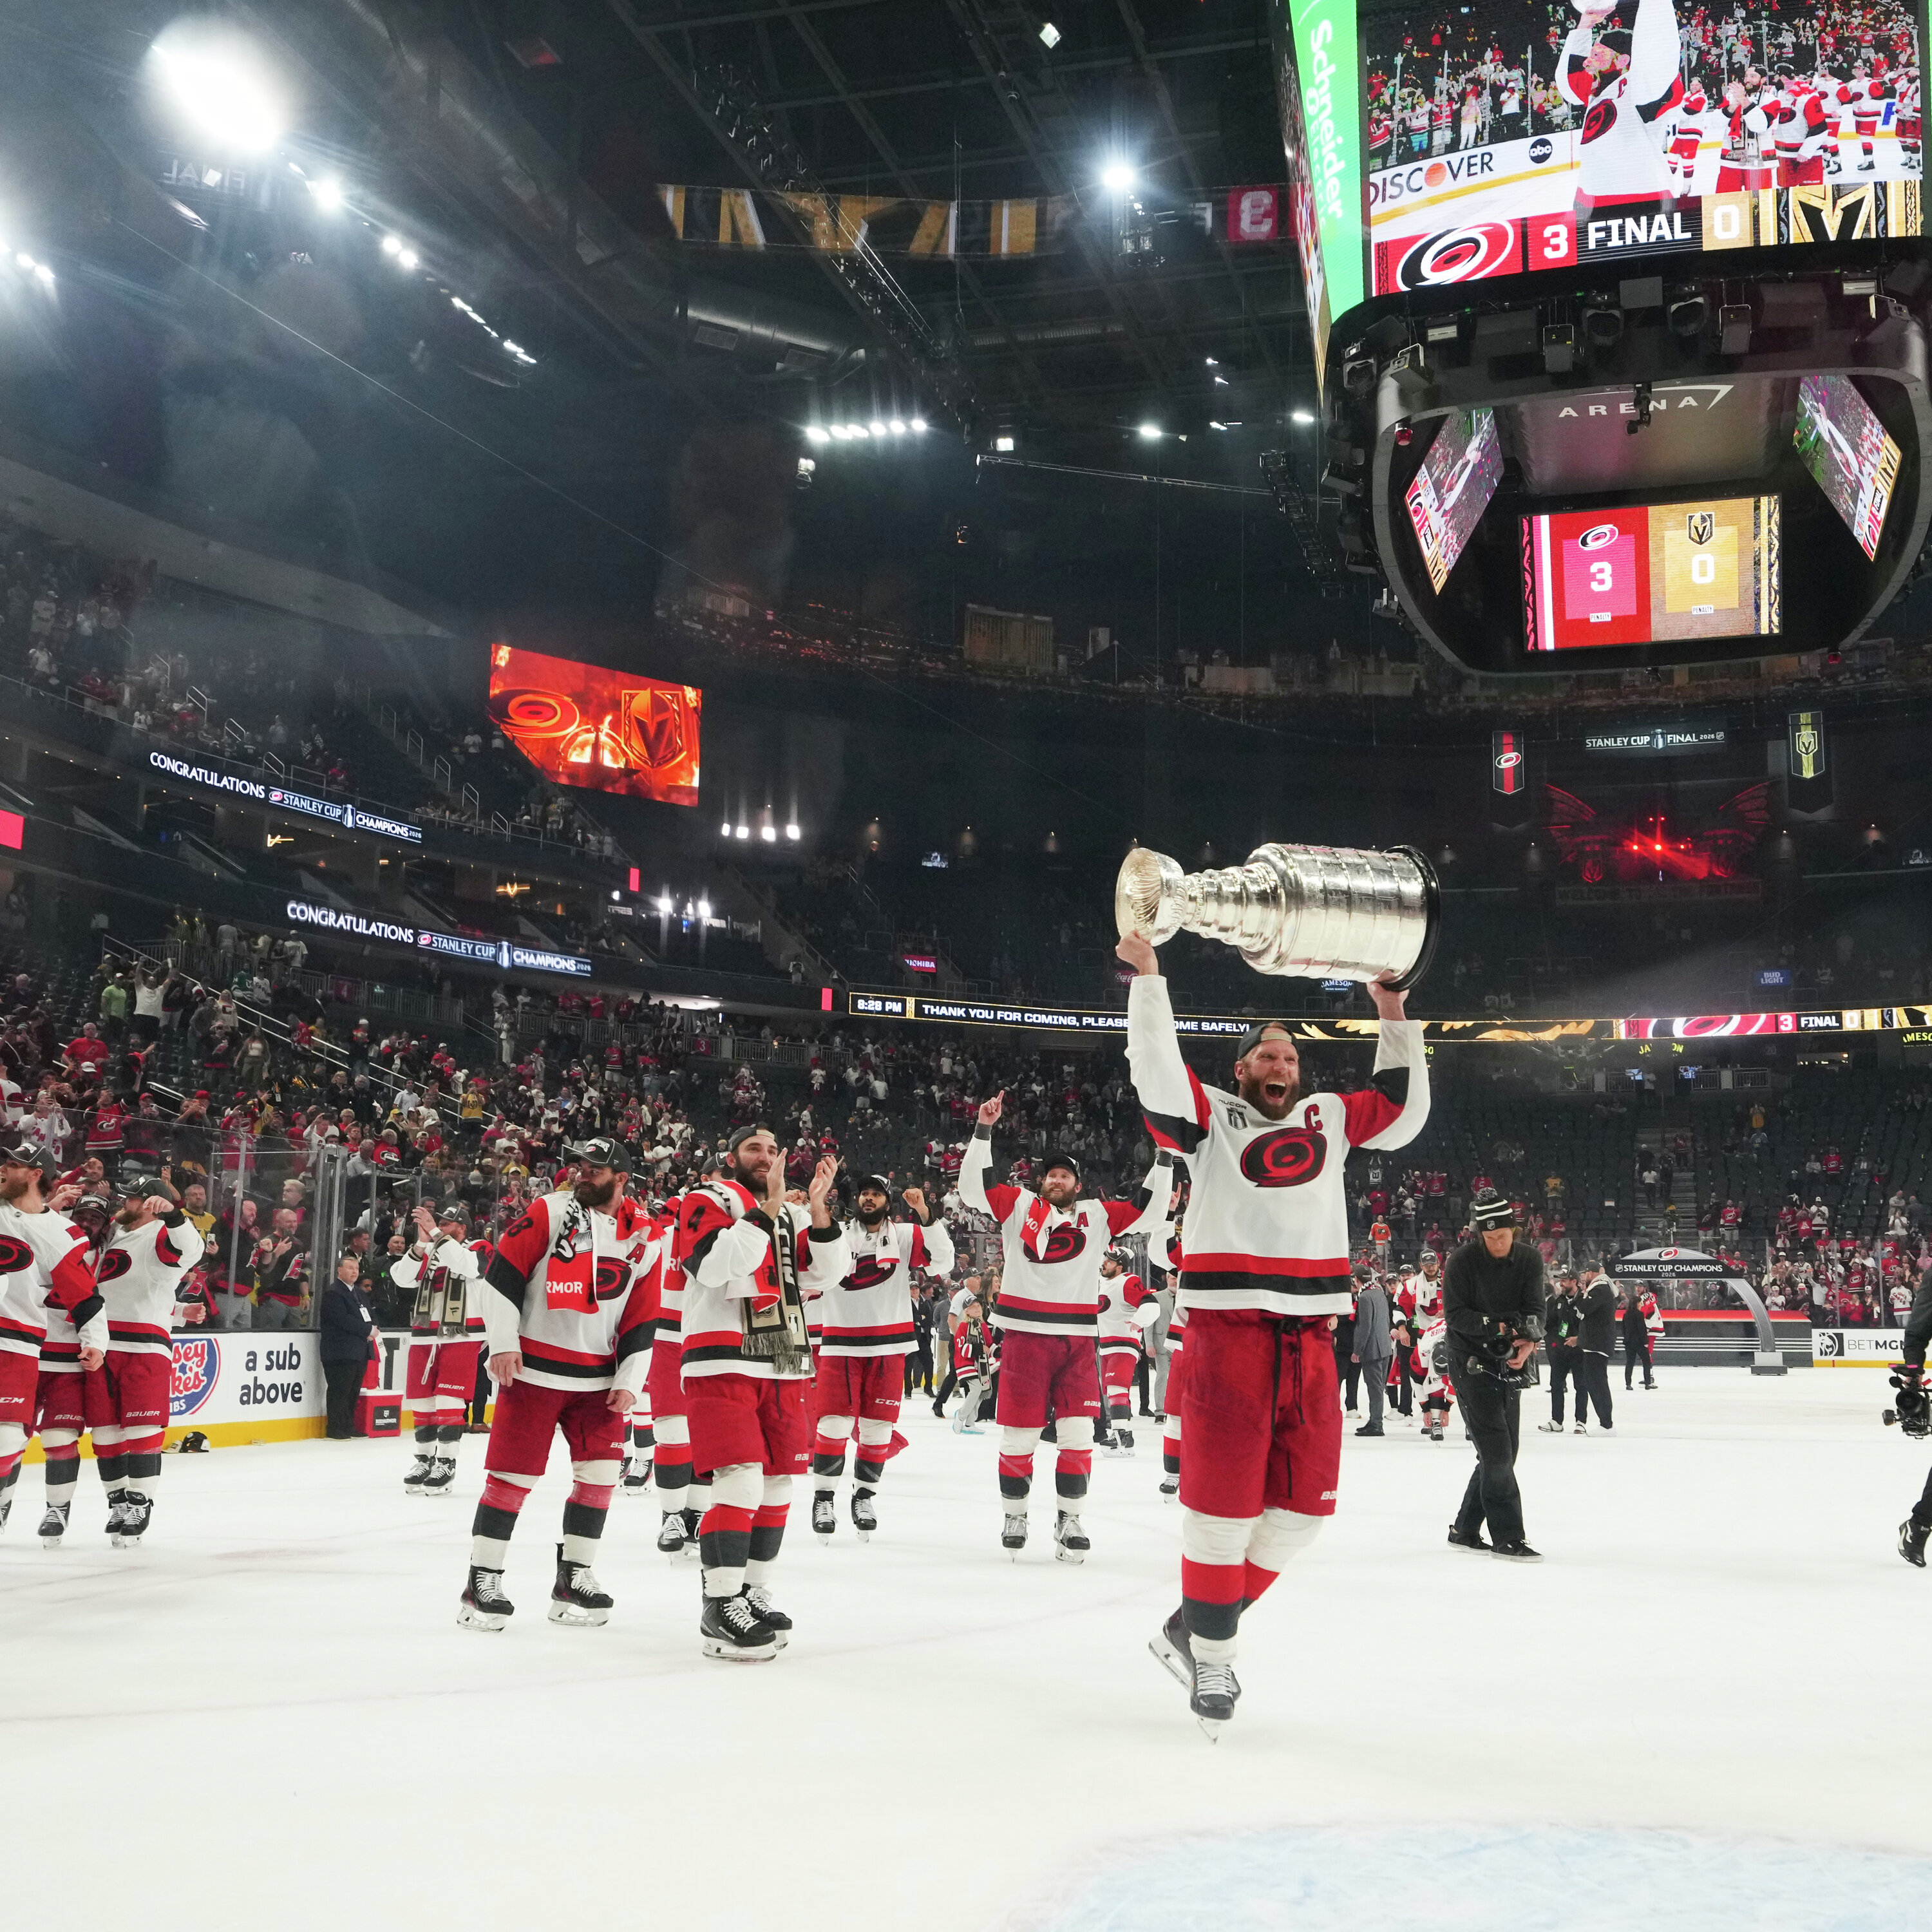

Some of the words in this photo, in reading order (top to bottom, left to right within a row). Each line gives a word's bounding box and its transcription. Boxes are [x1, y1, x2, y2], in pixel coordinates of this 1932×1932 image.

[1311, 19, 1345, 218] Schneider
[1530, 144, 1553, 158] abc
[1310, 120, 1325, 231] Electric
[1543, 224, 1568, 259] 3
[1587, 212, 1692, 249] FINAL
[1713, 204, 1739, 240] 0
[1558, 396, 1699, 418] ARENA
[1590, 562, 1613, 592] 3
[1691, 554, 1715, 584] 0
[1586, 737, 1629, 748] STANLEY
[1631, 735, 1651, 746] CUP
[1667, 734, 1698, 744] FINAL
[150, 752, 265, 799] CONGRATULATIONS
[283, 793, 323, 813] STANLEY
[324, 806, 341, 819] CUP
[355, 814, 409, 837] CHAMPIONS
[409, 830, 422, 838] 2026
[287, 901, 413, 943] CONGRATULATIONS
[432, 936, 476, 954] STANLEY
[475, 945, 495, 958] CUP
[513, 951, 576, 971] CHAMPIONS
[576, 963, 591, 972] 2026
[905, 959, 936, 968] OSHIBA
[857, 999, 882, 1012] 8:28
[885, 1001, 902, 1013] PM
[922, 1004, 966, 1018] THANK
[969, 1009, 994, 1019] YOU
[997, 1010, 1021, 1021] FOR
[1024, 1014, 1079, 1027] COMING,
[1083, 1017, 1129, 1028] PLEASE
[1173, 1021, 1198, 1030] OME
[1201, 1021, 1250, 1032] SAFELY!
[1780, 1015, 1793, 1031] 3
[1801, 1016, 1840, 1028] FINAL
[1845, 1012, 1859, 1028] 0
[1218, 1099, 1247, 1110] NUCOR
[1304, 1103, 1323, 1131] C
[1076, 1211, 1089, 1228] A
[626, 1242, 647, 1265] A
[245, 1350, 258, 1372] a
[265, 1342, 301, 1371] sub
[240, 1376, 303, 1405] above
[875, 1398, 900, 1407] CCM
